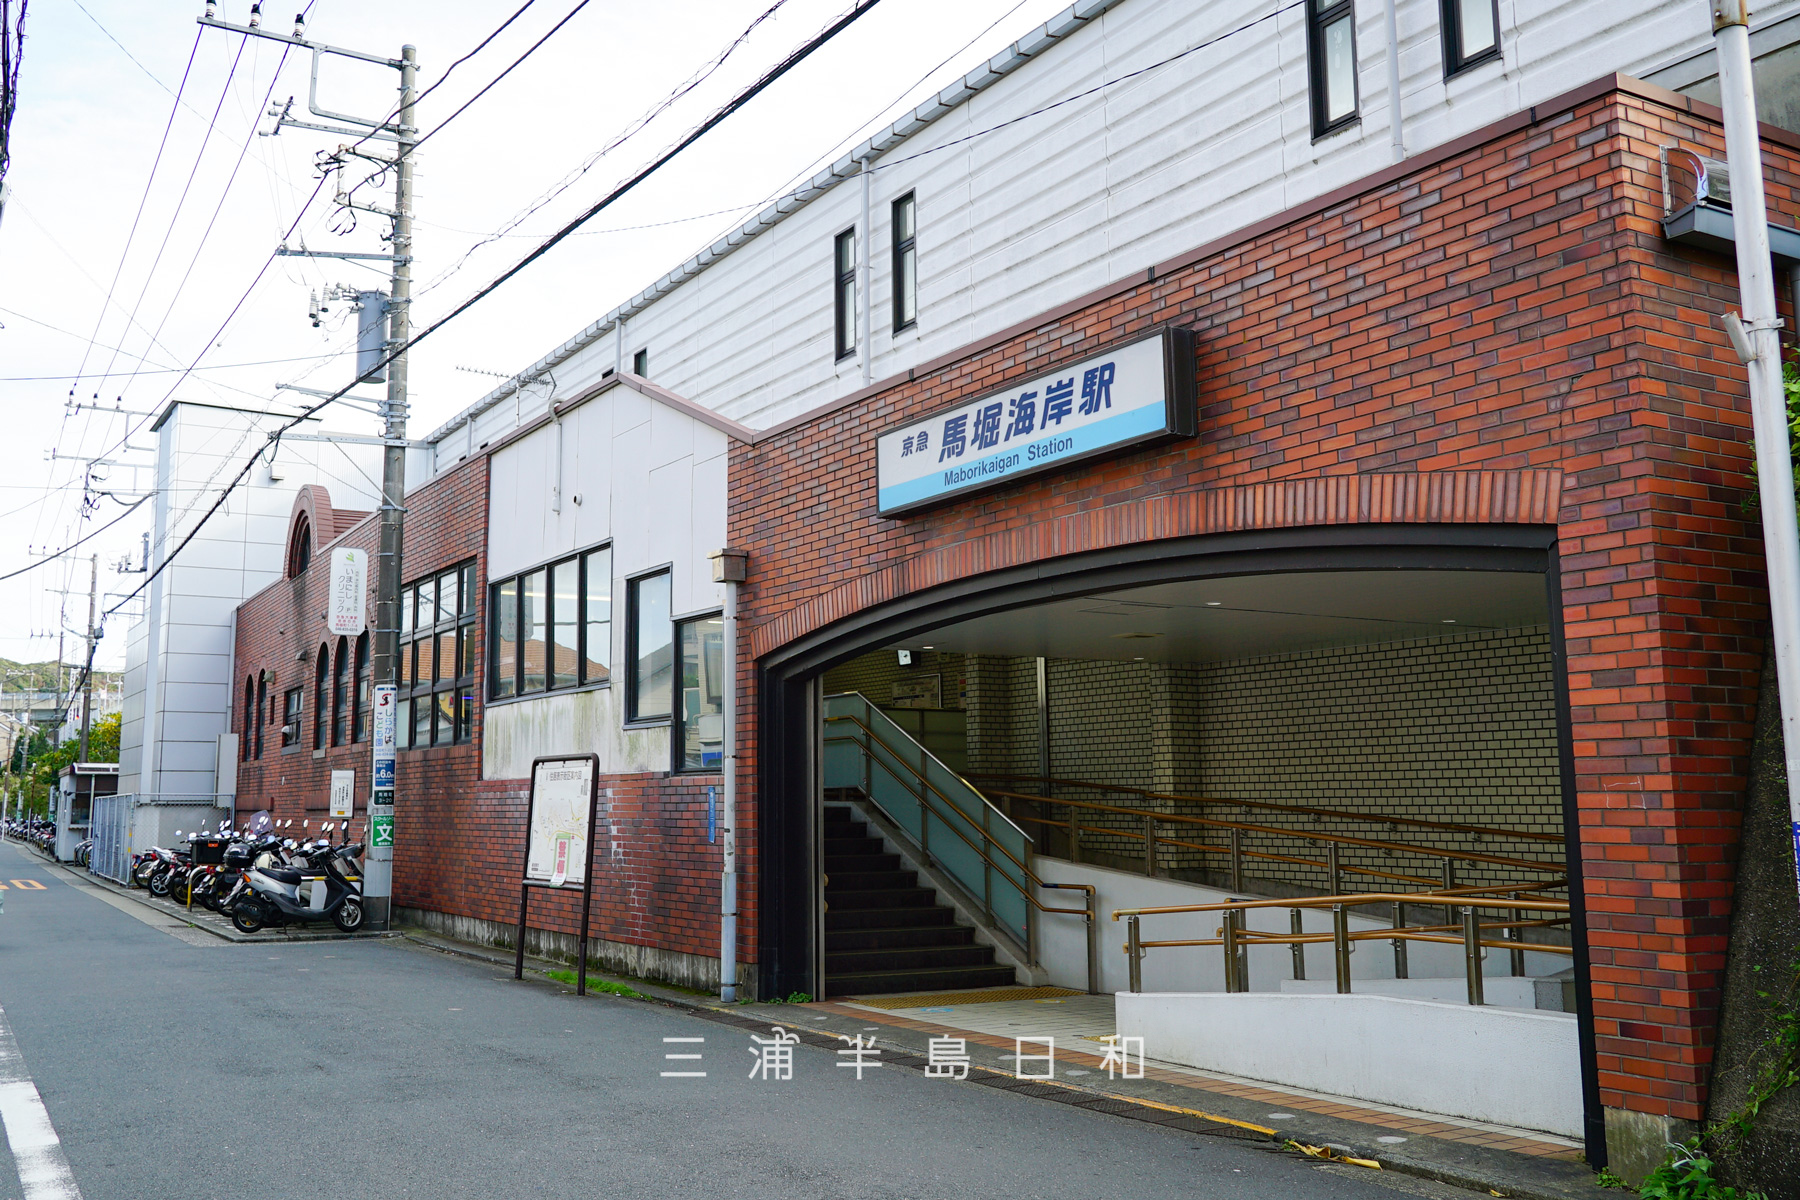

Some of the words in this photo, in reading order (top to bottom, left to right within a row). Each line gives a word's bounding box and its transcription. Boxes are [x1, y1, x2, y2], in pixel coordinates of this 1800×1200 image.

[901, 430, 929, 458] 京急
[938, 361, 1115, 463] 馬堀海岸駅
[944, 453, 1020, 486] Maborikaigan
[1028, 436, 1073, 461] Station
[337, 576, 345, 613] クリニック
[345, 568, 353, 599] いまにし
[376, 712, 384, 747] こども園
[384, 709, 393, 744] しらかば
[376, 823, 393, 842] 文
